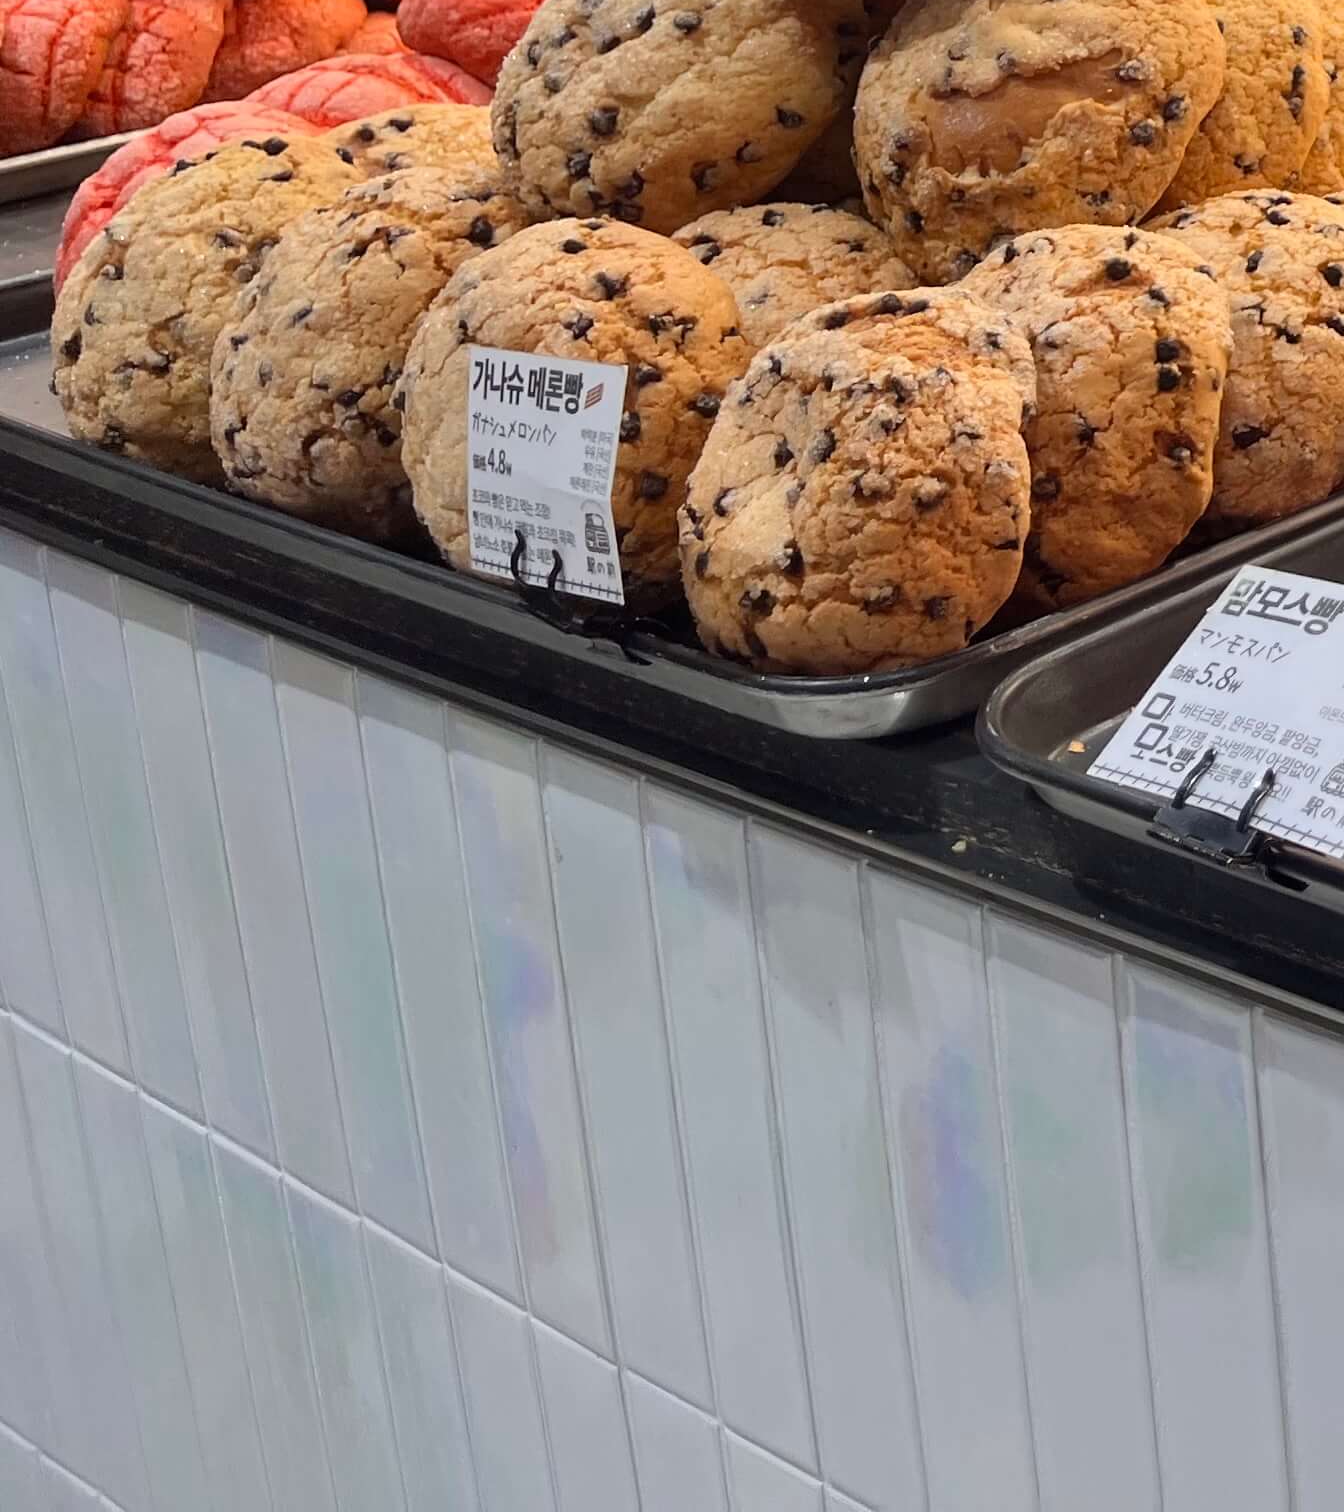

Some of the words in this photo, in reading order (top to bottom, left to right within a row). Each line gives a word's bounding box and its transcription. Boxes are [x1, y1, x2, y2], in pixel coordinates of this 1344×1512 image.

[473, 358, 524, 406] 가나슈
[527, 367, 584, 415] 메론빵
[1201, 629, 1290, 663] マンモスパン
[1266, 753, 1320, 784] 아낌없이
